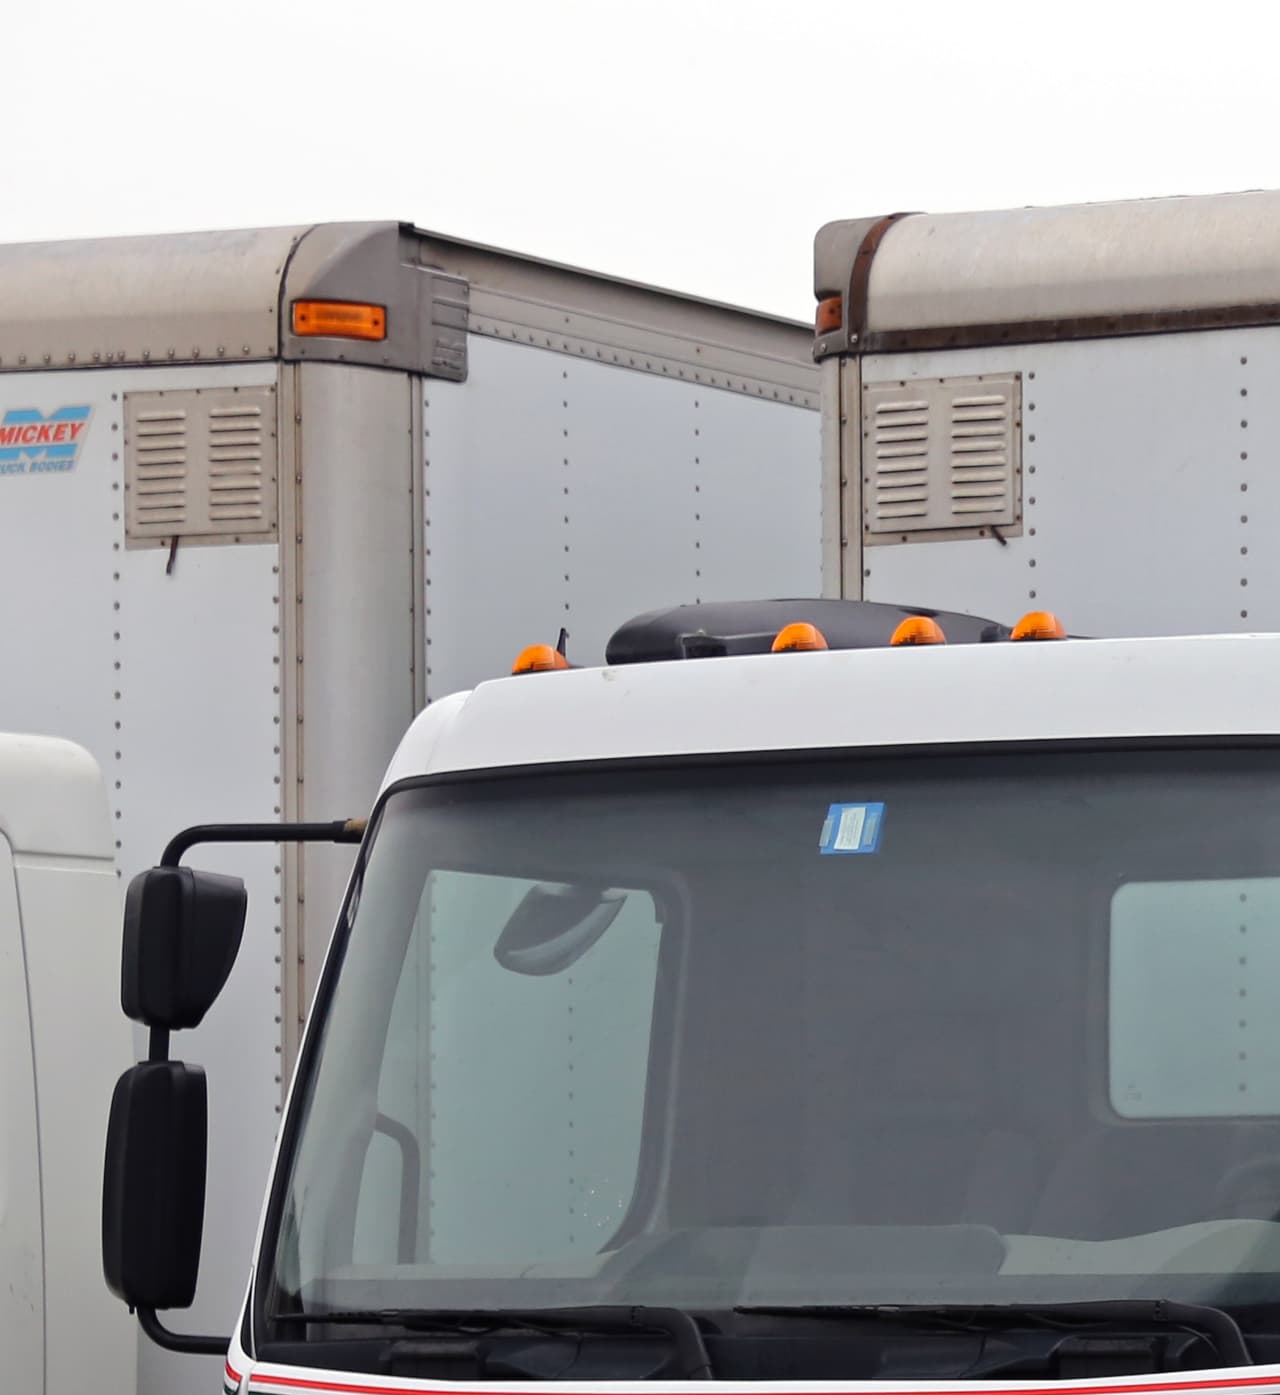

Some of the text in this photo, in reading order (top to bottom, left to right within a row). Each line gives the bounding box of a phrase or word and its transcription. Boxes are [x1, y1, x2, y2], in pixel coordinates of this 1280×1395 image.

[0, 422, 84, 446] MICKEY
[0, 460, 74, 475] UCK BODIES
